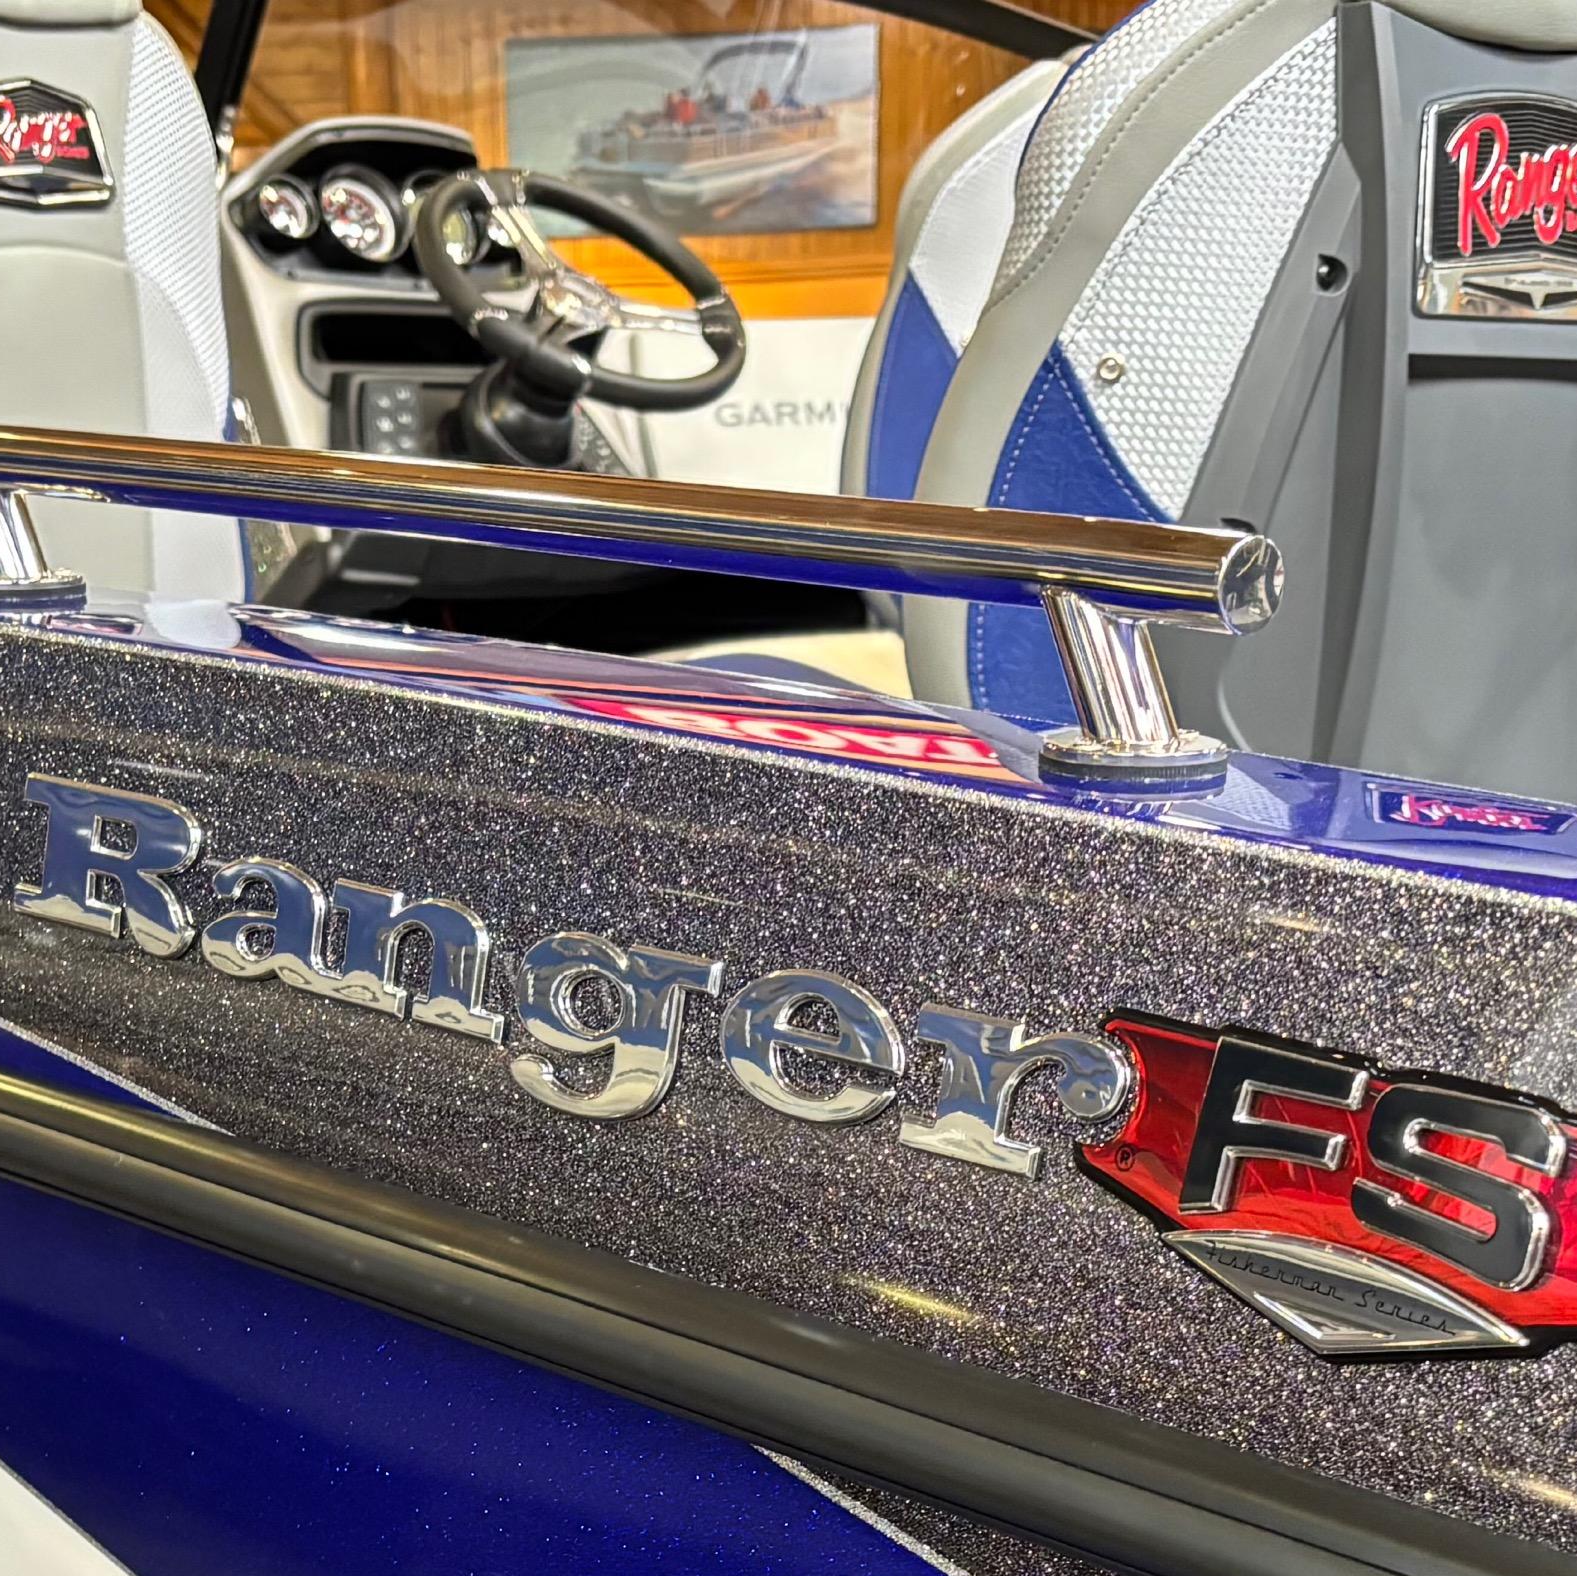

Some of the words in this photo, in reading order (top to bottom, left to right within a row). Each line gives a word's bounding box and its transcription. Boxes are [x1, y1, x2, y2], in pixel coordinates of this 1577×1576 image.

[713, 401, 849, 428] GARM
[12, 771, 1137, 1179] Ranger
[1177, 1033, 1569, 1292] FS
[1204, 1238, 1346, 1303] Fisherman
[1354, 1287, 1458, 1338] Series
